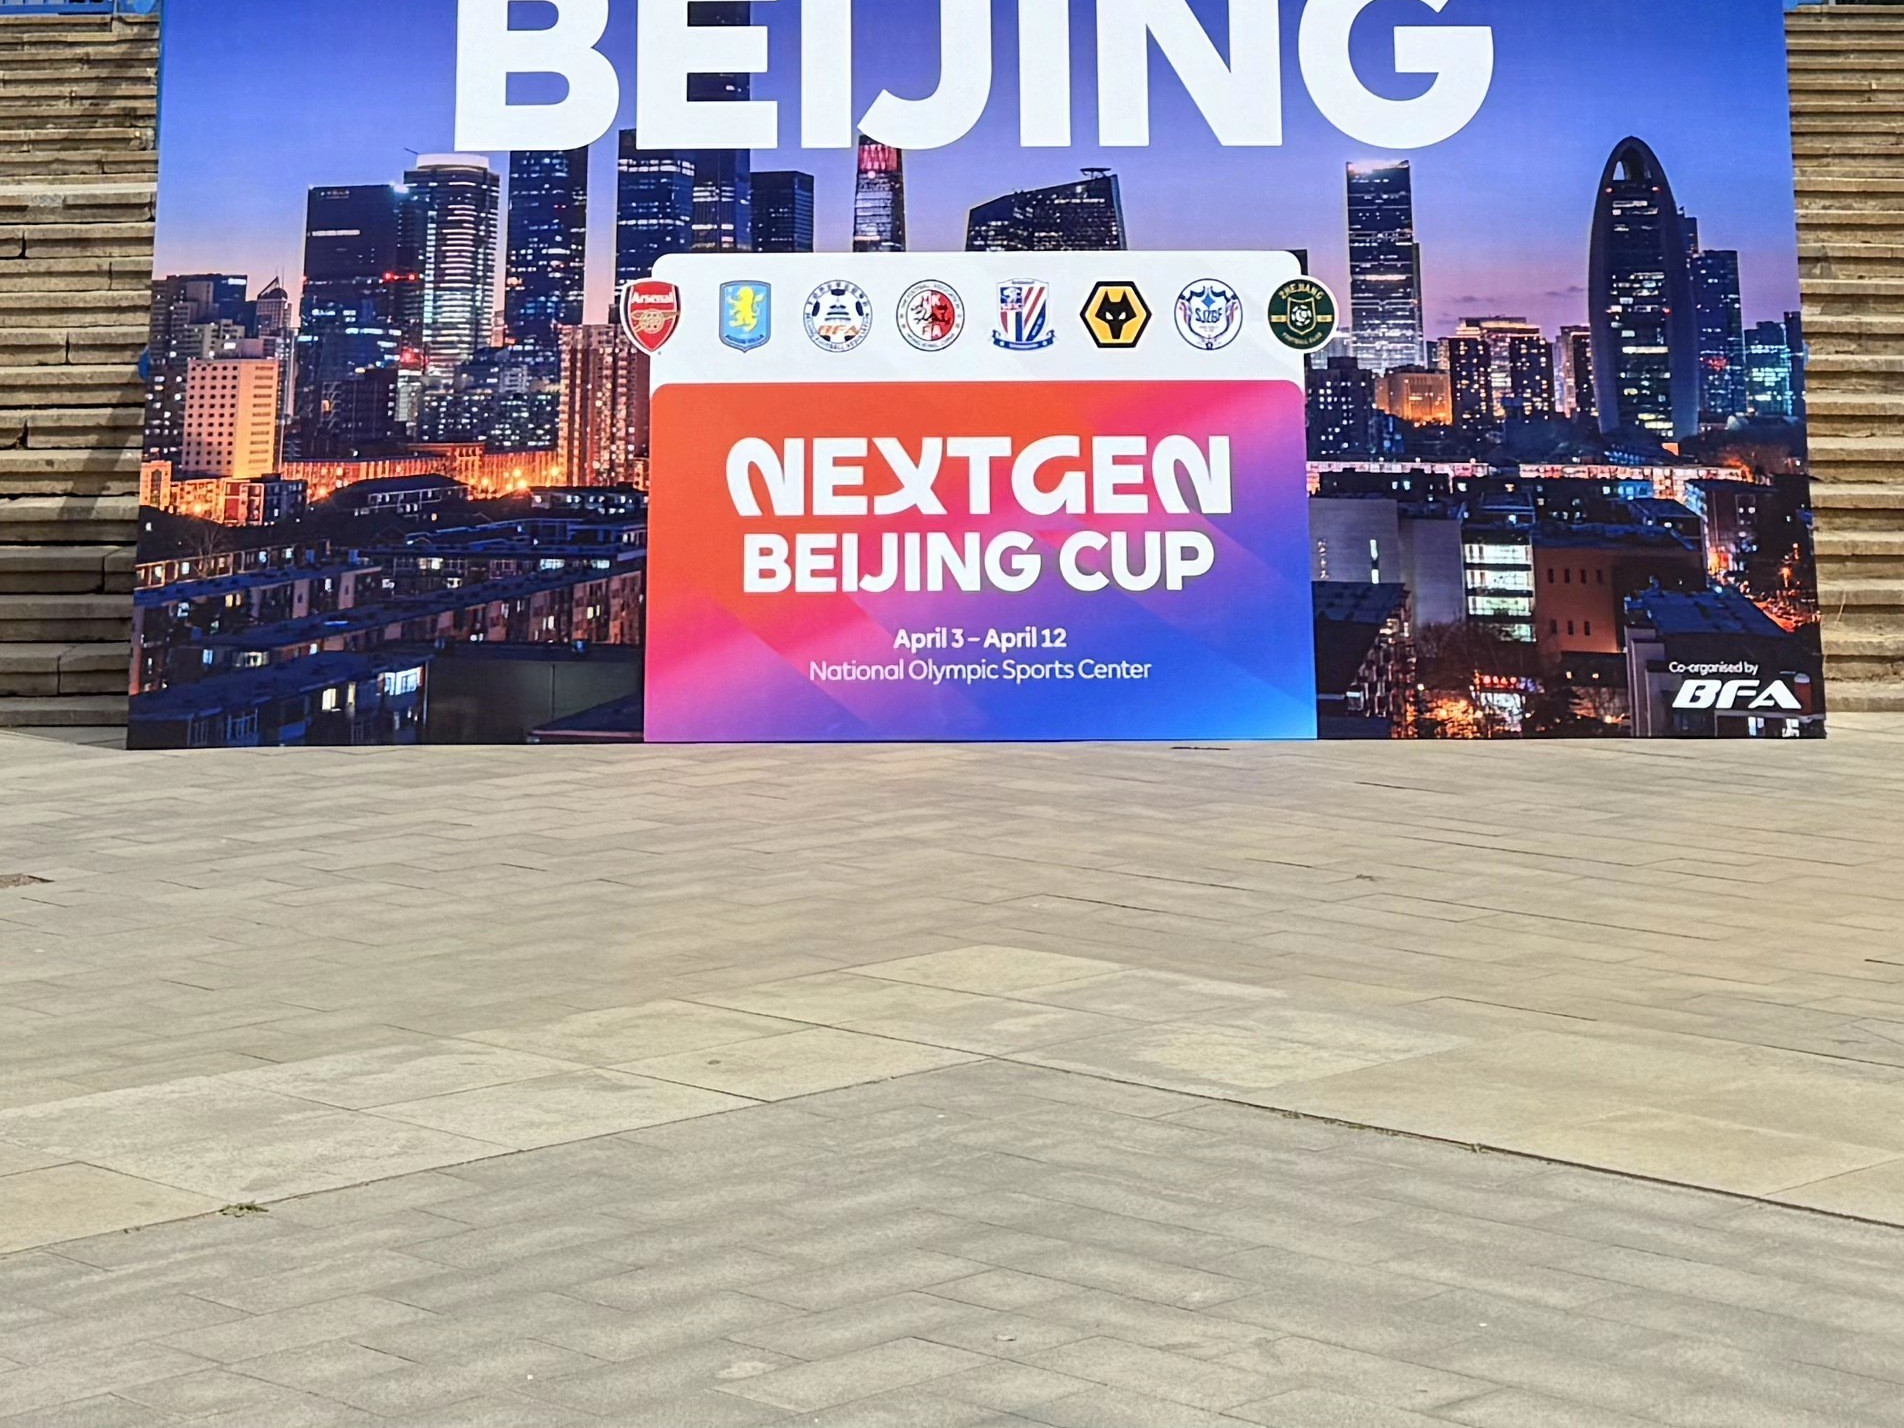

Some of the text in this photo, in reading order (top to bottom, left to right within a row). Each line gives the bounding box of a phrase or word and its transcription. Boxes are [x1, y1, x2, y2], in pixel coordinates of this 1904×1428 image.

[725, 434, 1232, 517] NEXTGEN
[743, 530, 1215, 593] BEIJING CUP
[893, 627, 947, 653] April
[951, 628, 964, 648] 3
[983, 626, 1037, 653] April
[1041, 627, 1067, 648] 12
[809, 658, 1152, 685] National Olympic Sports Center
[1669, 661, 1759, 676] Co-organised by
[1672, 679, 1802, 709] BFA
